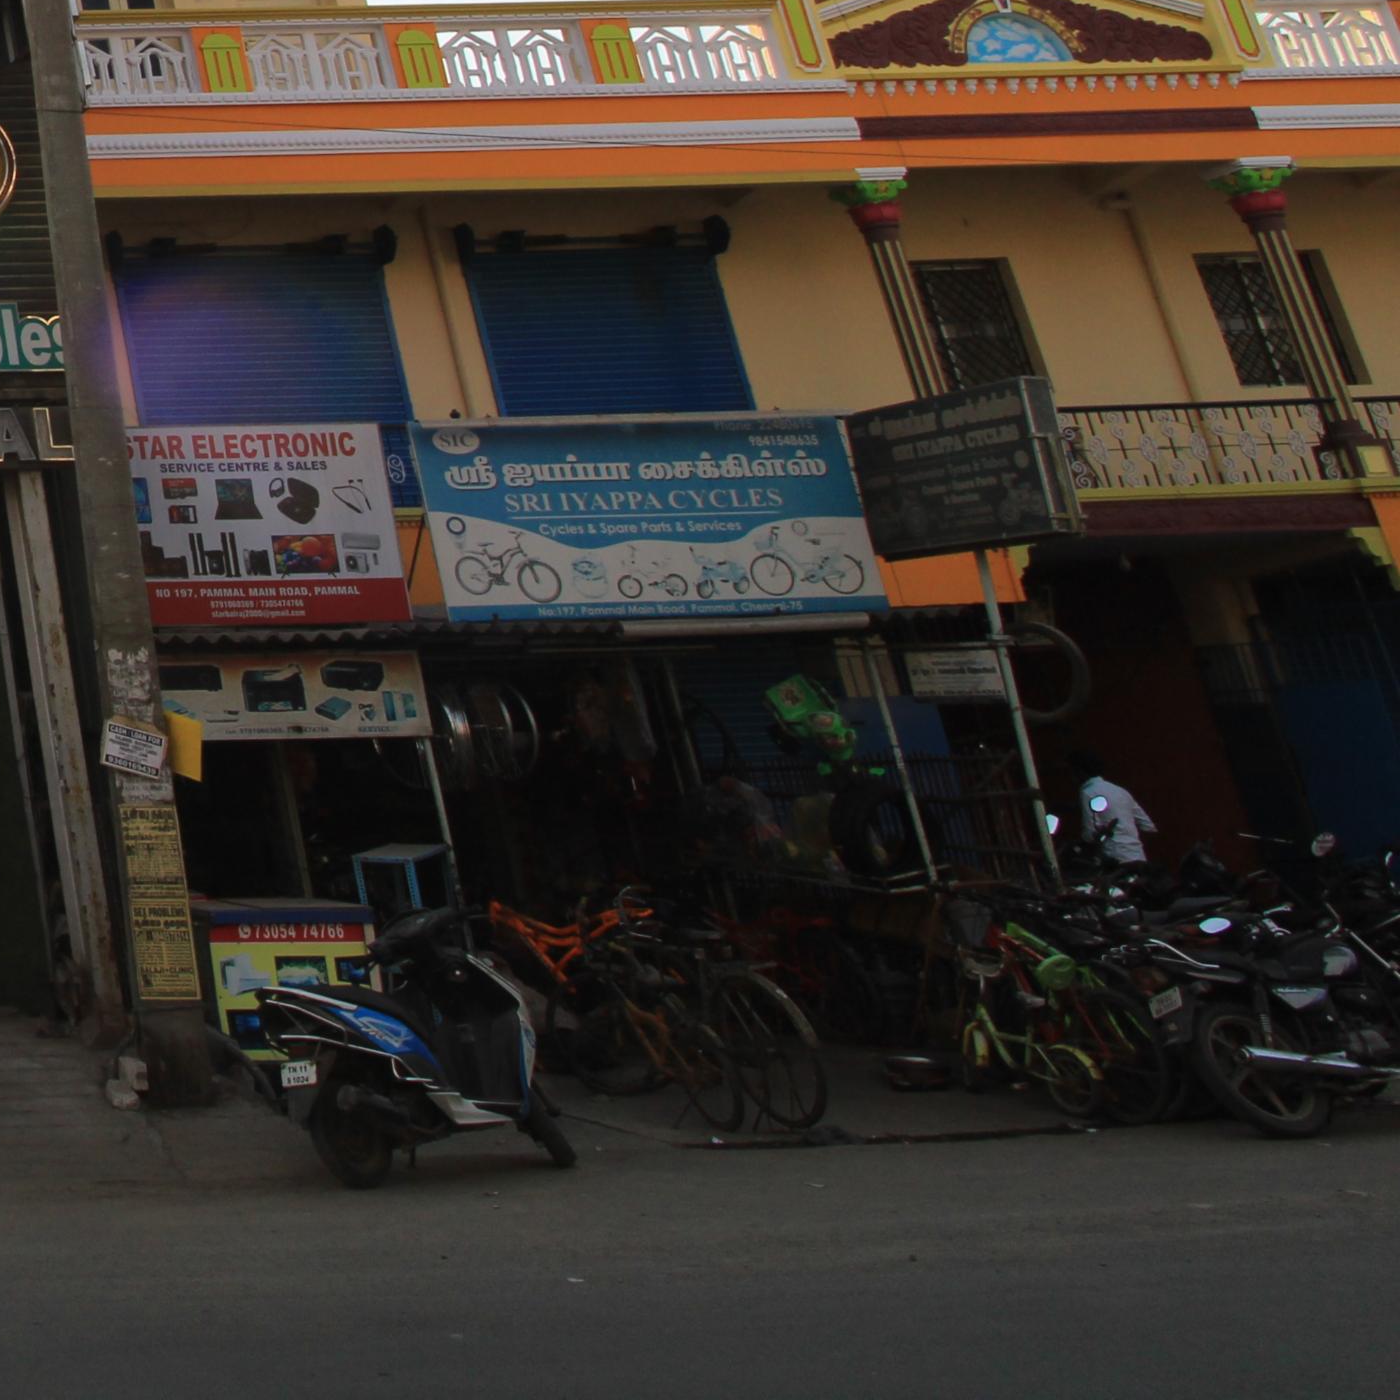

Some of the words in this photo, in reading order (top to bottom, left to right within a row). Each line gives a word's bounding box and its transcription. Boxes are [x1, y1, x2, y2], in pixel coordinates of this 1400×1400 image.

[193, 431, 356, 459] ELECTRONIC
[438, 432, 474, 449] SIC
[160, 461, 215, 473] SERVICE
[219, 460, 271, 473] CENTRE
[274, 460, 283, 472] &
[287, 460, 328, 472] SALES
[505, 491, 550, 514] SRI
[561, 490, 666, 512] IYAPPA
[667, 487, 784, 510] CYCLES
[539, 524, 584, 536] Cycles
[588, 523, 597, 534] &
[599, 522, 637, 535] Spare
[641, 521, 673, 533] Parts
[675, 520, 684, 532] &
[689, 519, 742, 532] Services
[200, 587, 245, 598] PAMMAL
[248, 587, 276, 598] MAIN
[279, 586, 311, 598] ROAD,
[314, 585, 360, 597] PAMMAL
[254, 924, 296, 939] 73054
[302, 923, 344, 938] 74766
